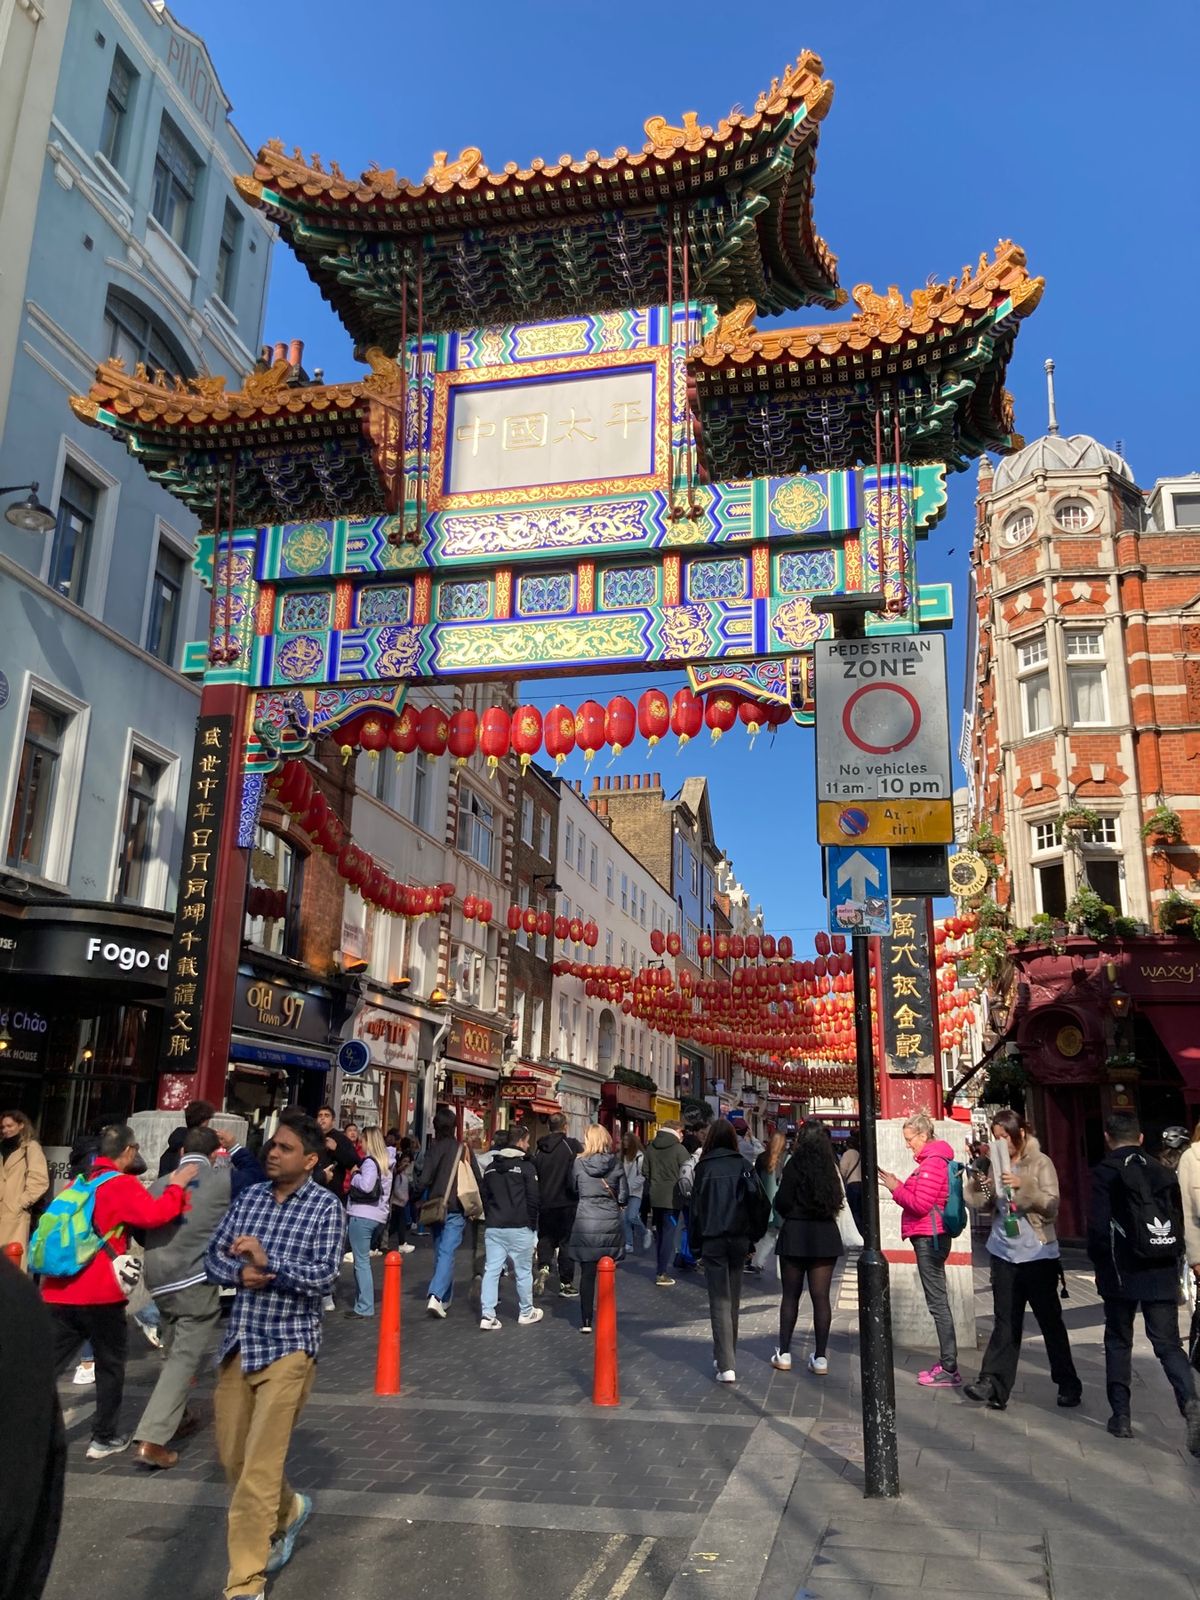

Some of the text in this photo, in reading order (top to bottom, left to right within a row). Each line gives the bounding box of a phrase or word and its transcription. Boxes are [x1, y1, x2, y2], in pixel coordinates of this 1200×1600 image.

[167, 34, 218, 133] PINOLI
[456, 400, 649, 457] 中國太平
[829, 640, 931, 657] PEDESTRIAN
[843, 658, 917, 679] ZONE
[840, 762, 928, 776] No vehicles
[827, 782, 838, 794] 11
[843, 784, 864, 794] am
[881, 778, 904, 794] 10
[909, 781, 940, 796] pm
[86, 938, 169, 971] Fogo d
[247, 987, 273, 1010] Old
[13, 1012, 47, 1033] Chão
[258, 1007, 280, 1027] Town
[282, 994, 305, 1030] 97
[13, 1050, 38, 1062] HOUSE
[1150, 1236, 1177, 1245] adidas
